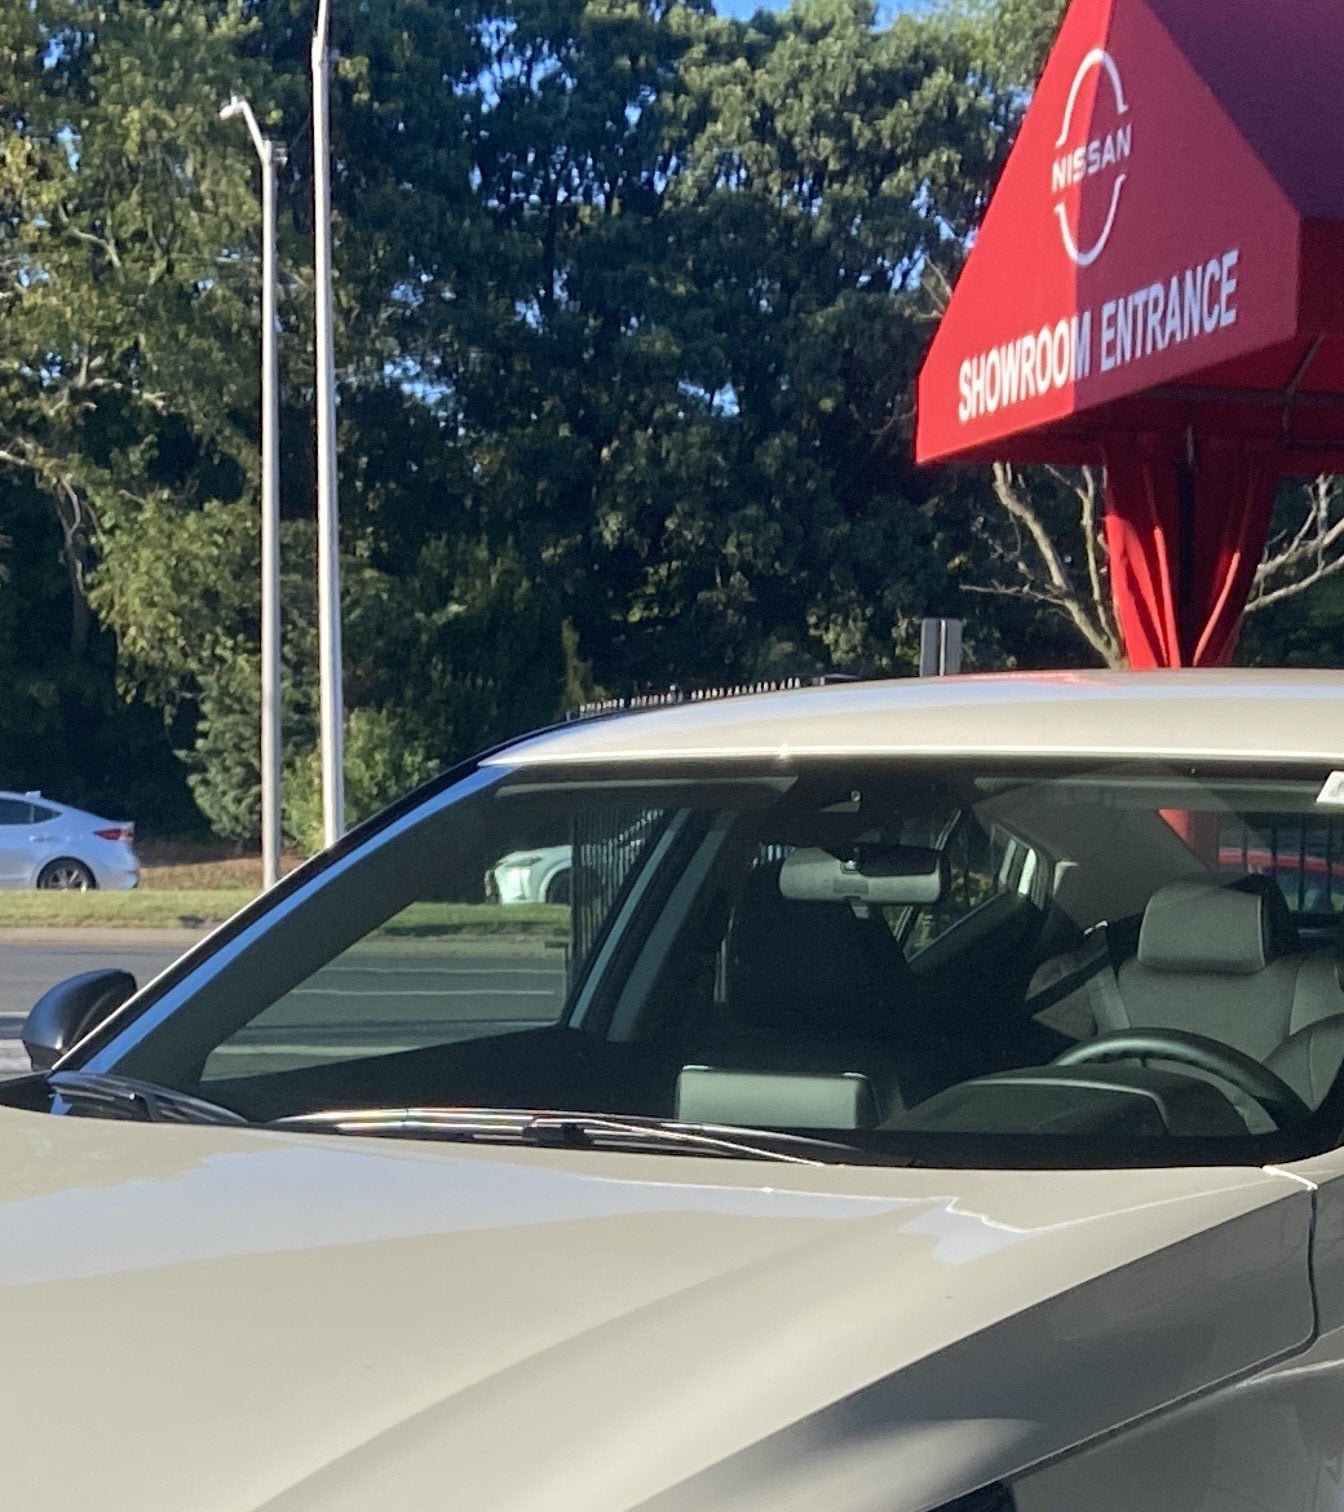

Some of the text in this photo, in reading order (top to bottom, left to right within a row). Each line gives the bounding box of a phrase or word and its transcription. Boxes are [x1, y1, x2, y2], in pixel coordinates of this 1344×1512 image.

[1051, 123, 1133, 193] NISSAN
[958, 246, 1239, 424] SHOWROOM ENTRANCE
